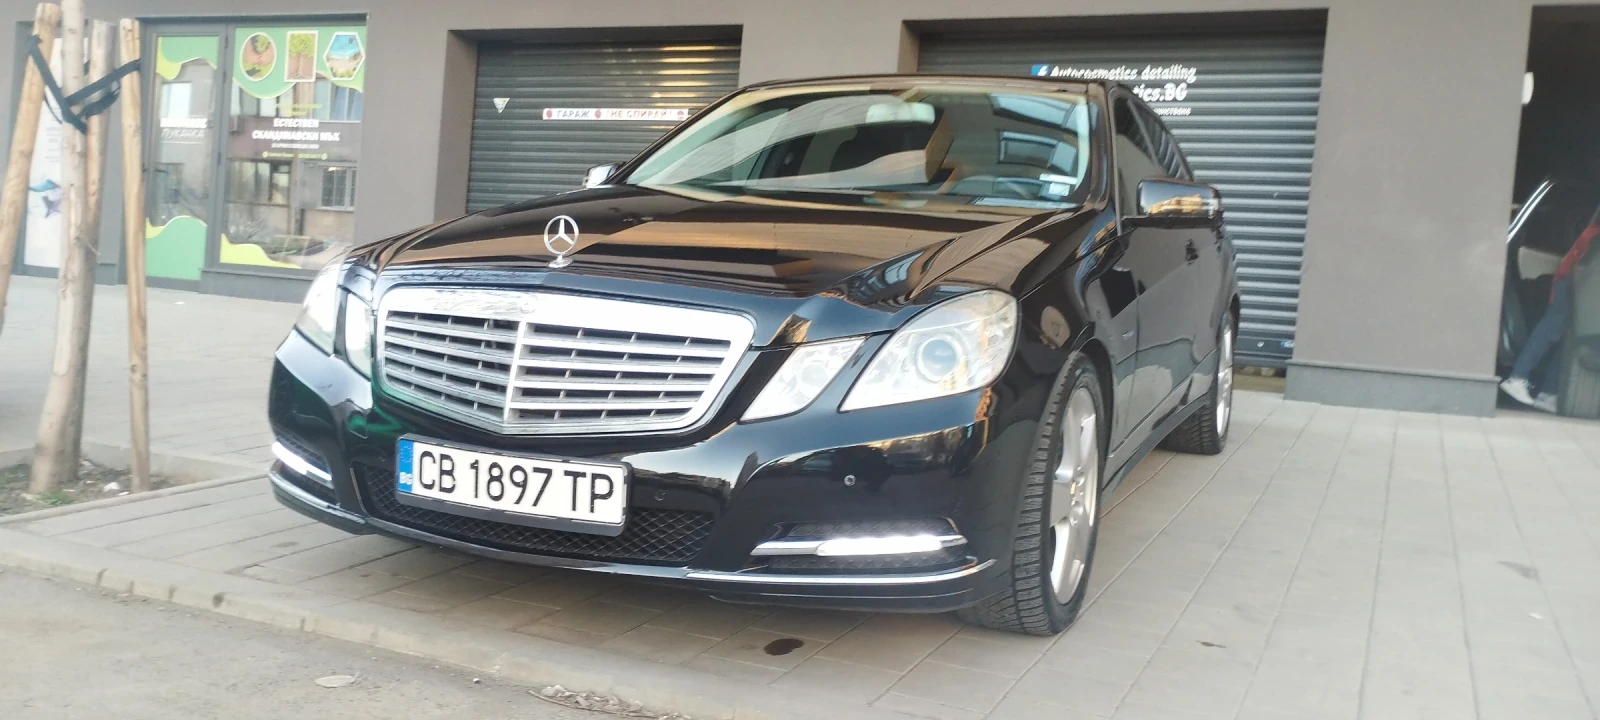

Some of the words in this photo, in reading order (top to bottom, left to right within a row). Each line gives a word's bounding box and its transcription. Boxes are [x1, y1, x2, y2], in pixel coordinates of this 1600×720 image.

[1141, 64, 1197, 84] detailing
[557, 110, 590, 118] ГАРАЖ
[273, 118, 319, 128] ЕСТЕСТВЕН
[419, 450, 455, 494] CB
[470, 459, 553, 507] 1897
[564, 470, 614, 513] TP
